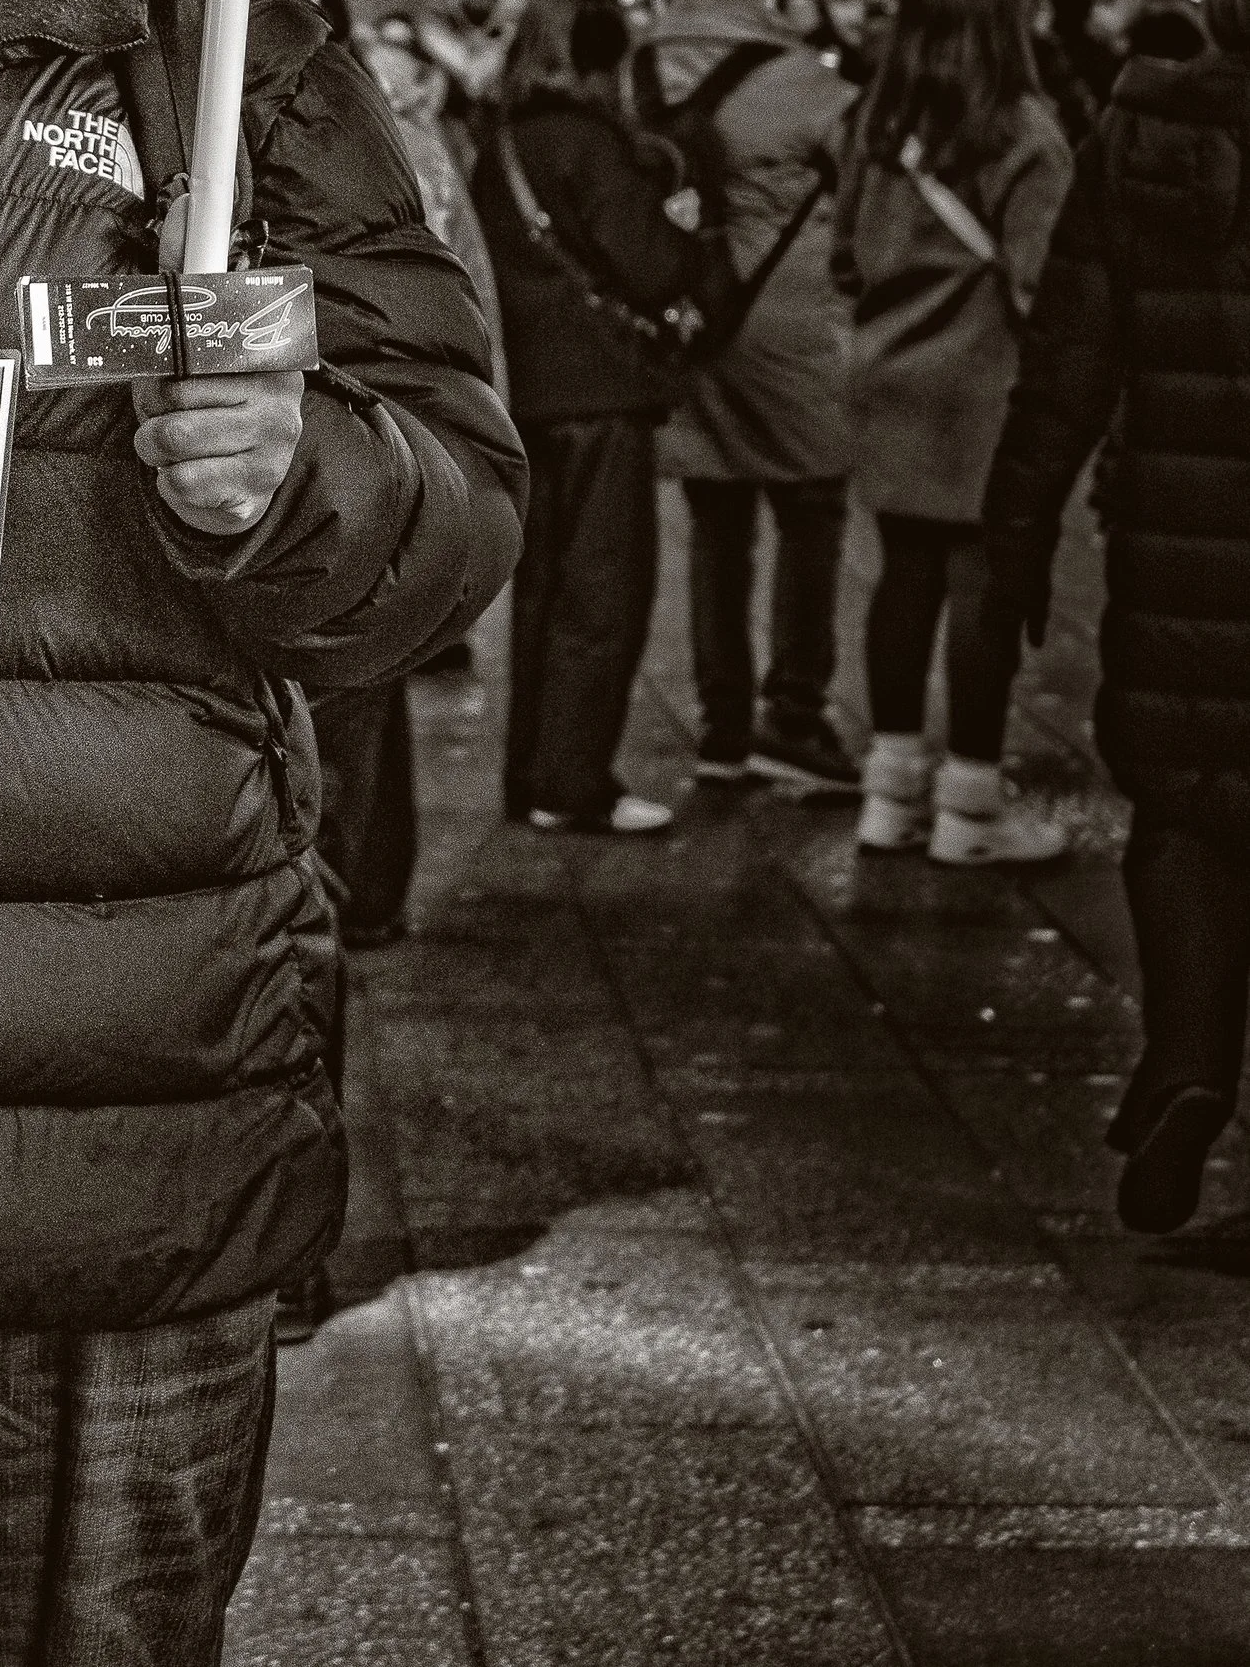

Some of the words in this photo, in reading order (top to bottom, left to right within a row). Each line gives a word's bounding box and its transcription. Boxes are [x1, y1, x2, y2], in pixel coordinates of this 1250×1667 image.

[23, 120, 117, 158] NORTH
[67, 109, 119, 140] THE
[50, 146, 115, 180] FACE
[86, 283, 308, 354] Broaway
[141, 313, 163, 323] CLUB
[206, 339, 223, 348] THE
